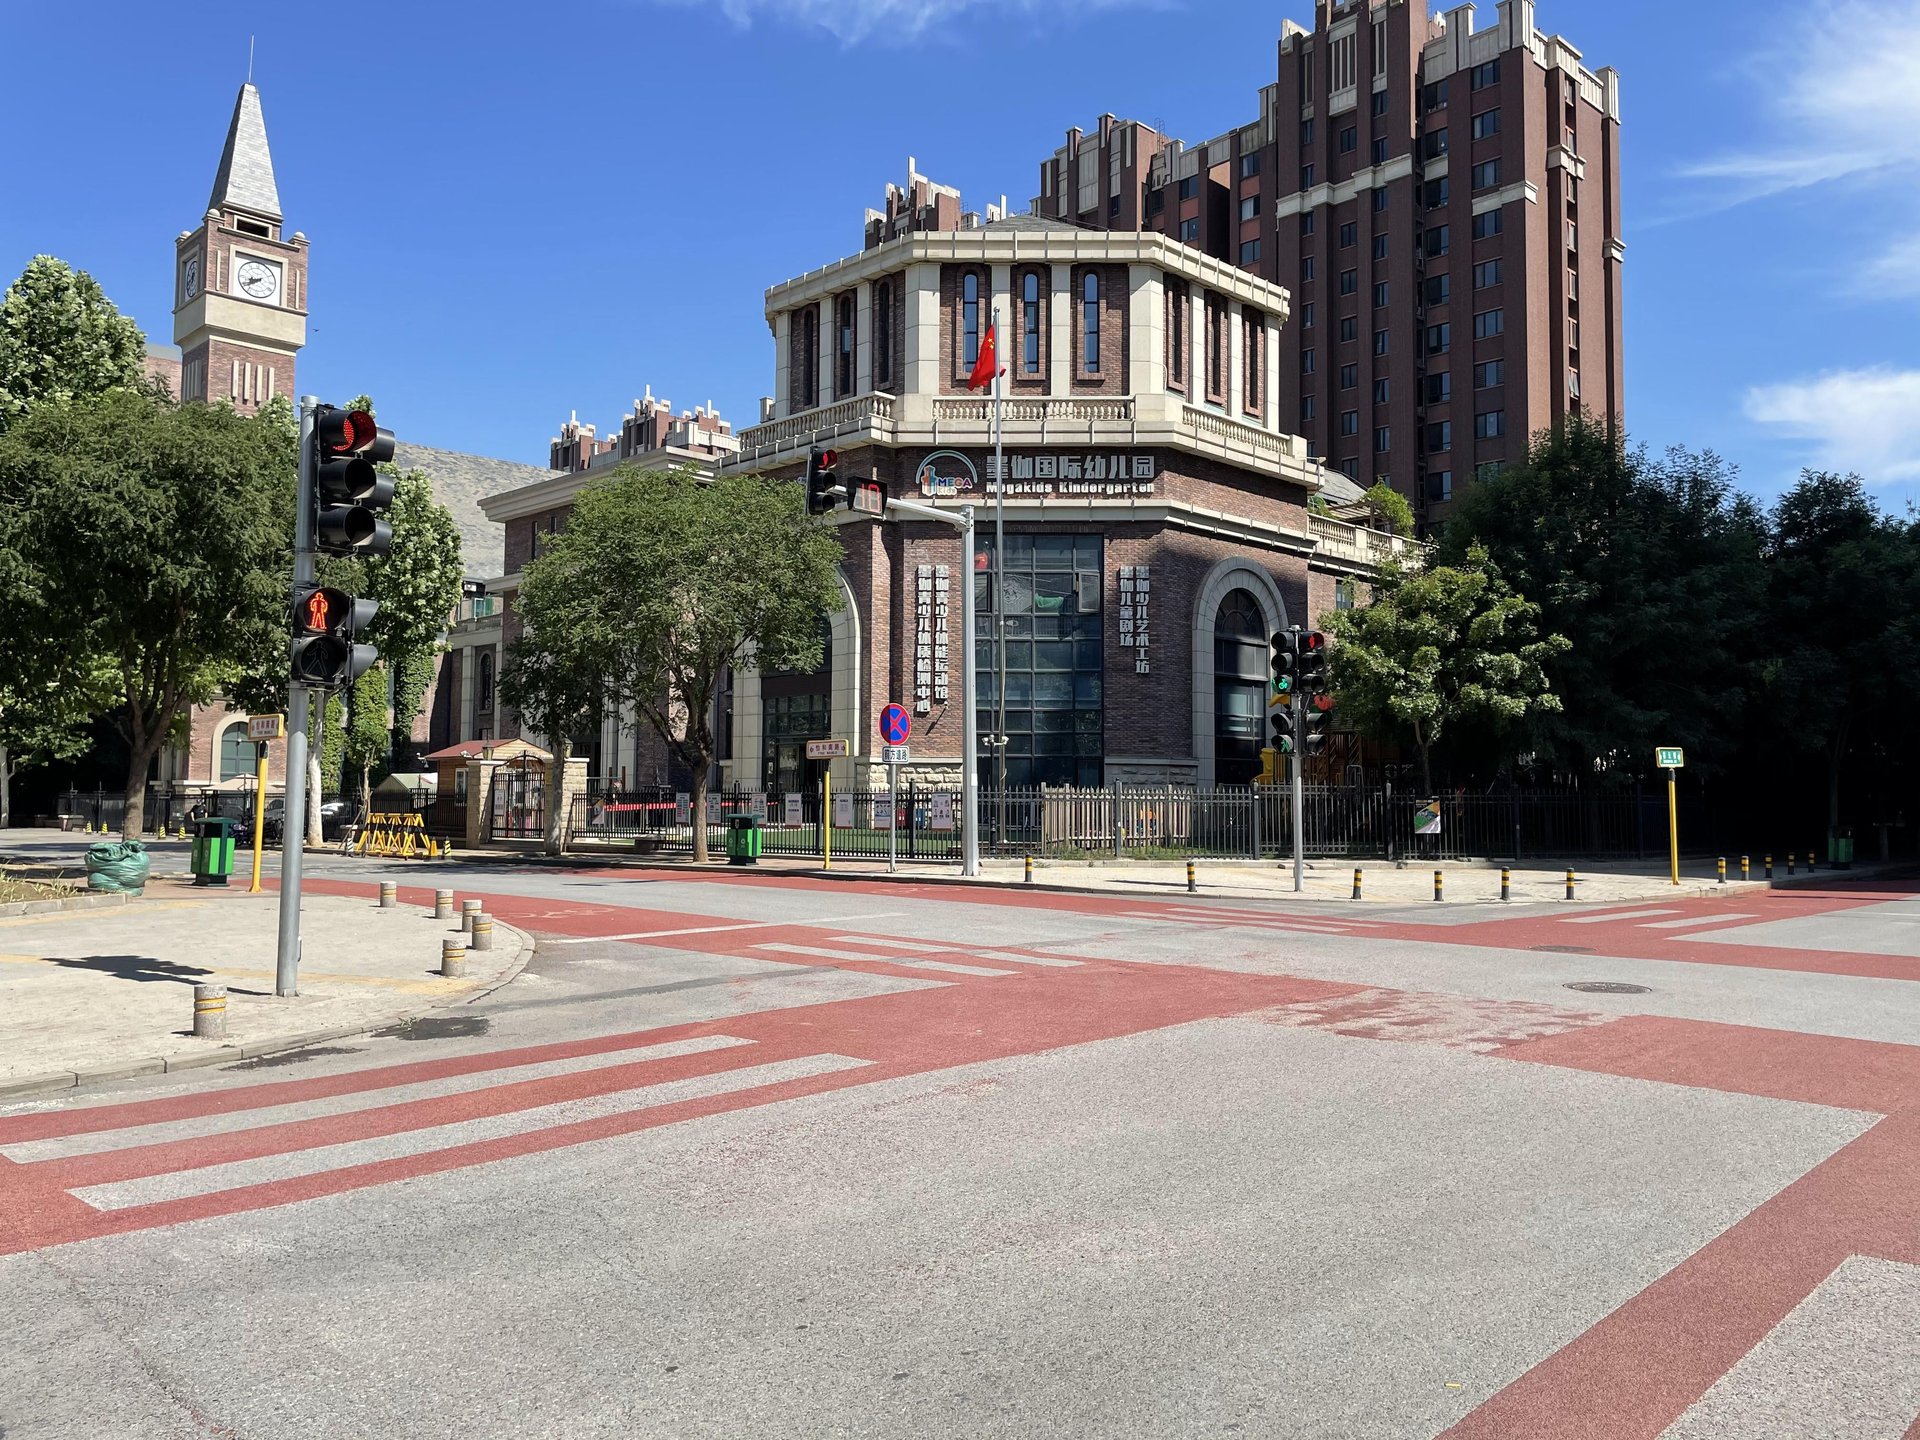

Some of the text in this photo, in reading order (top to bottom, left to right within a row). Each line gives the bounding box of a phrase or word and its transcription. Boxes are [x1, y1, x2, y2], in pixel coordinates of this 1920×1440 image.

[986, 455, 1155, 479] 墨伽国际幼儿园
[938, 477, 972, 489] MEGA
[1059, 482, 1155, 494] Kindergarten
